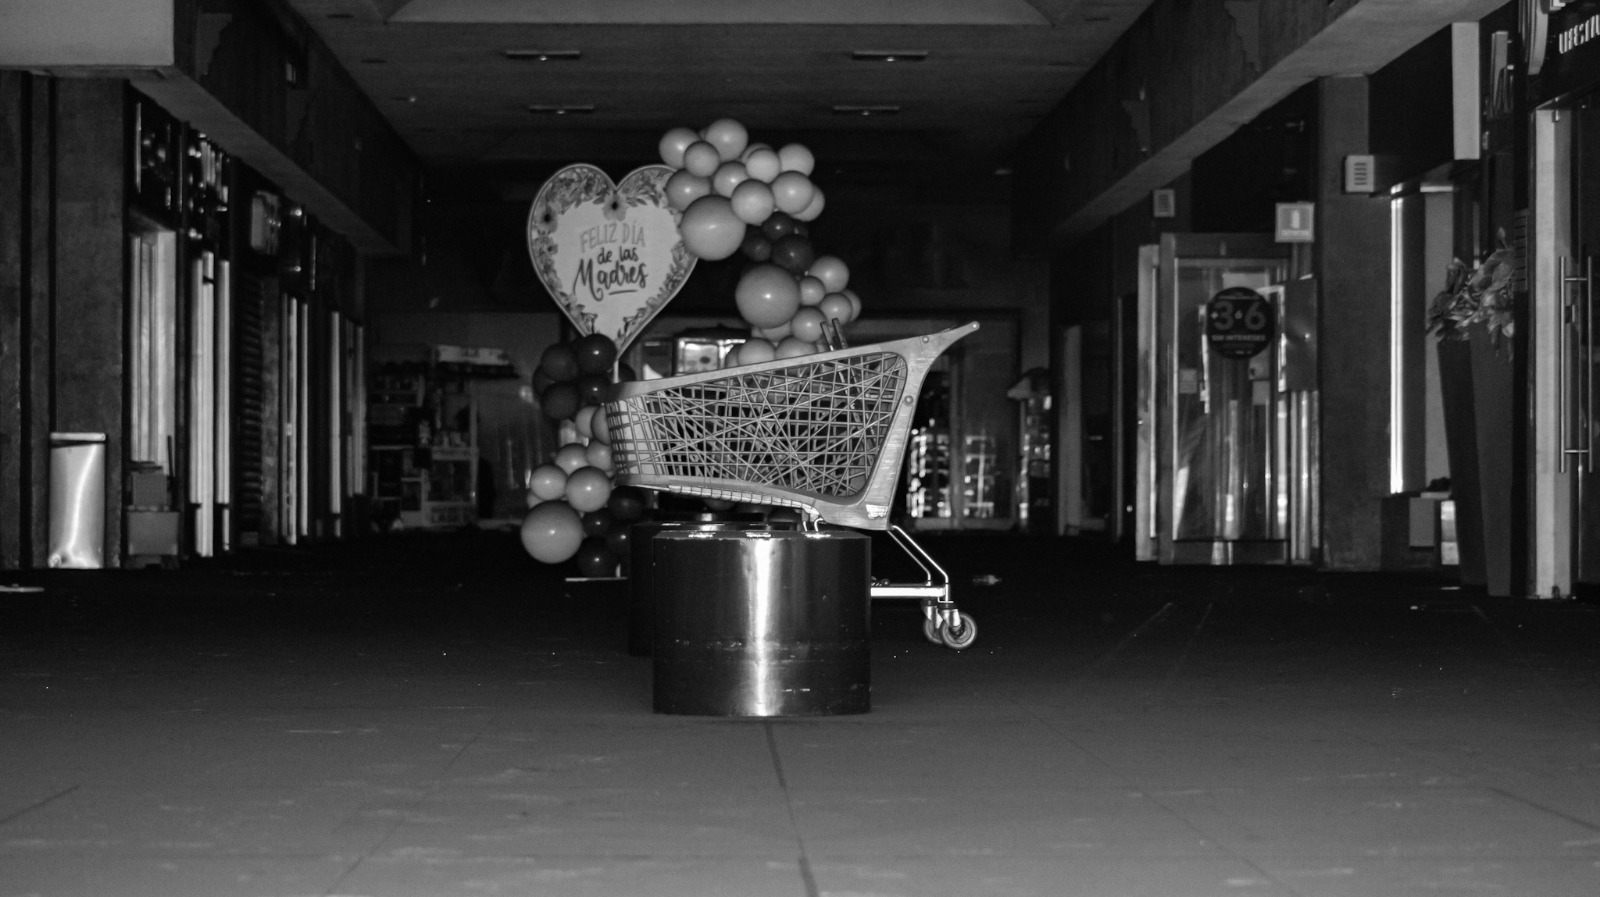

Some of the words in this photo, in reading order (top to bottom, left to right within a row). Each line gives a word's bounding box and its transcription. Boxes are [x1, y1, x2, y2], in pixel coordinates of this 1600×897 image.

[580, 222, 617, 253] FELIZ
[622, 220, 646, 248] DÍA
[597, 247, 613, 264] de
[619, 246, 639, 262] las
[573, 258, 649, 302] Madres
[1213, 301, 1234, 331] 3
[1244, 301, 1266, 331] 6
